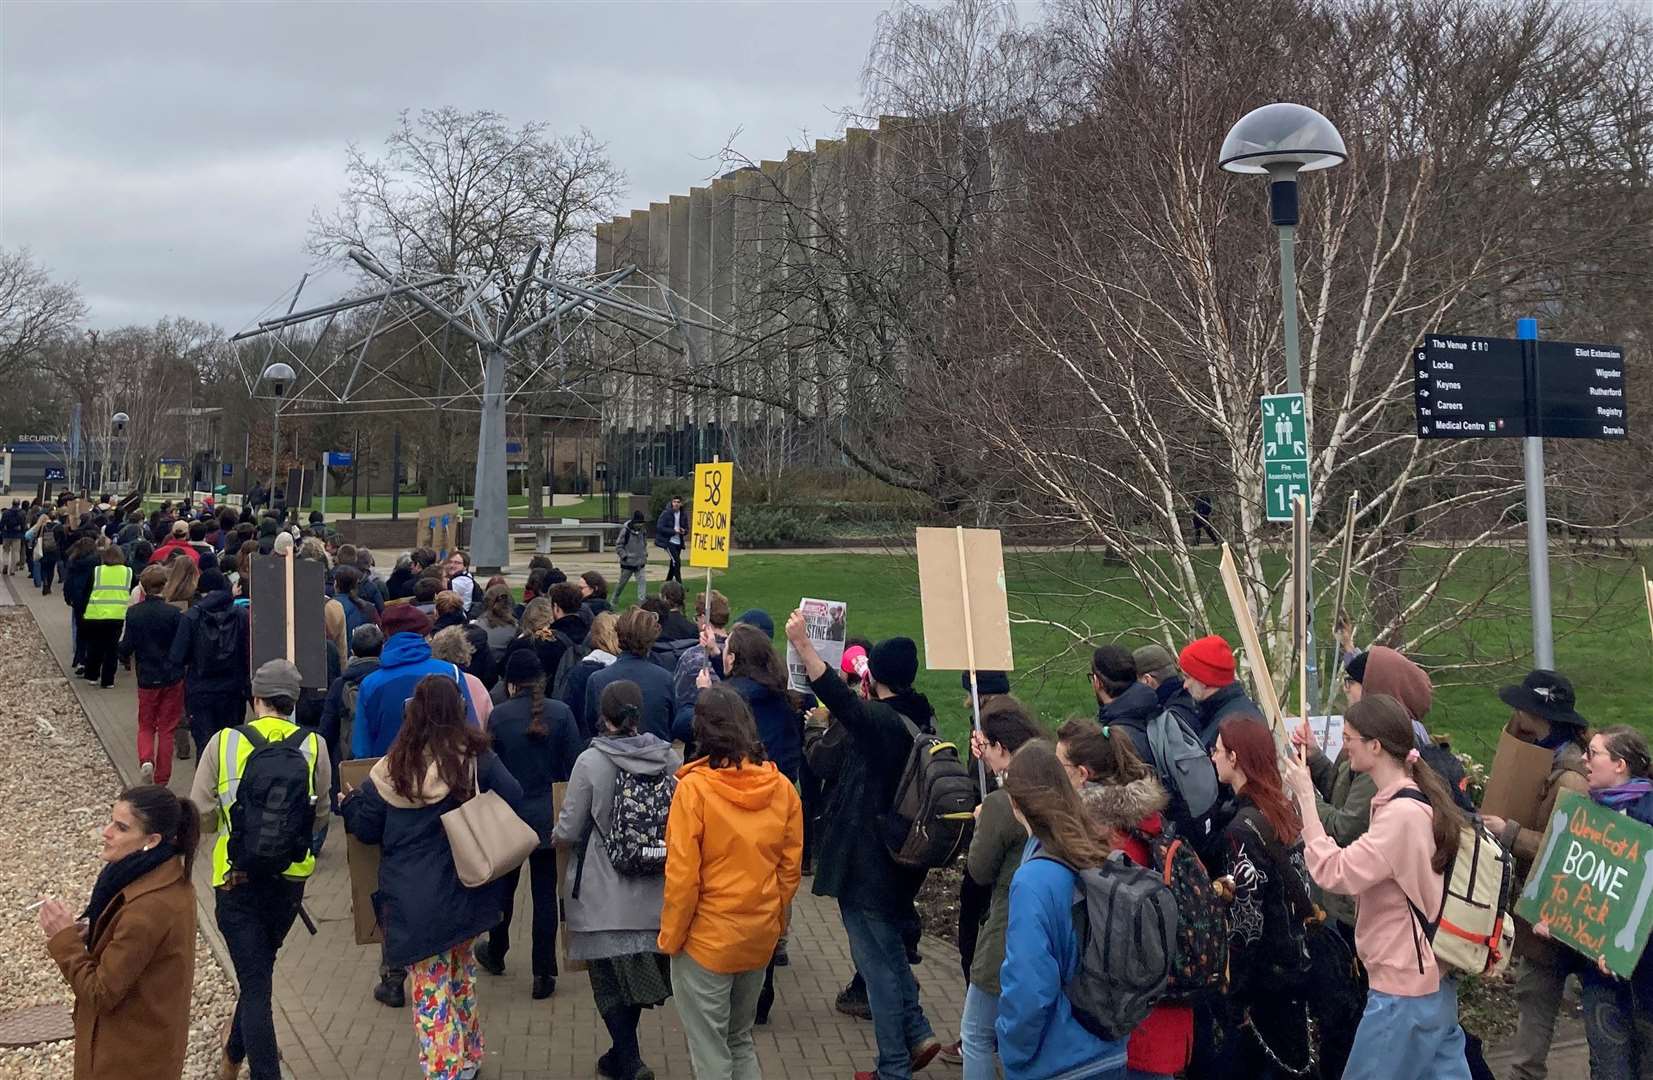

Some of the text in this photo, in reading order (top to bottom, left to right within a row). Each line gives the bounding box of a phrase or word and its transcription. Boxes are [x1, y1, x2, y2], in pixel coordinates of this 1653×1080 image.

[1431, 338, 1446, 349] The
[1446, 339, 1468, 350] Venue
[1575, 348, 1621, 359] Eliot Extension
[1432, 360, 1454, 370] Locke
[1436, 380, 1462, 392] Keynes
[1589, 386, 1622, 397] Rutherford
[1437, 400, 1463, 411] Careers
[1596, 406, 1623, 418] Registry
[1435, 419, 1486, 432] Medical Centre
[1602, 425, 1625, 436] Darwin
[18, 434, 60, 442] SECURITY
[704, 470, 722, 506] 58
[1274, 483, 1302, 512] 15
[697, 511, 727, 530] JOBS ON
[693, 532, 726, 552] THE LINE
[1602, 822, 1629, 858] Got
[1625, 840, 1640, 864] A
[1562, 840, 1629, 900] BONE
[1551, 873, 1609, 926] To Pick
[1540, 900, 1574, 934] With
